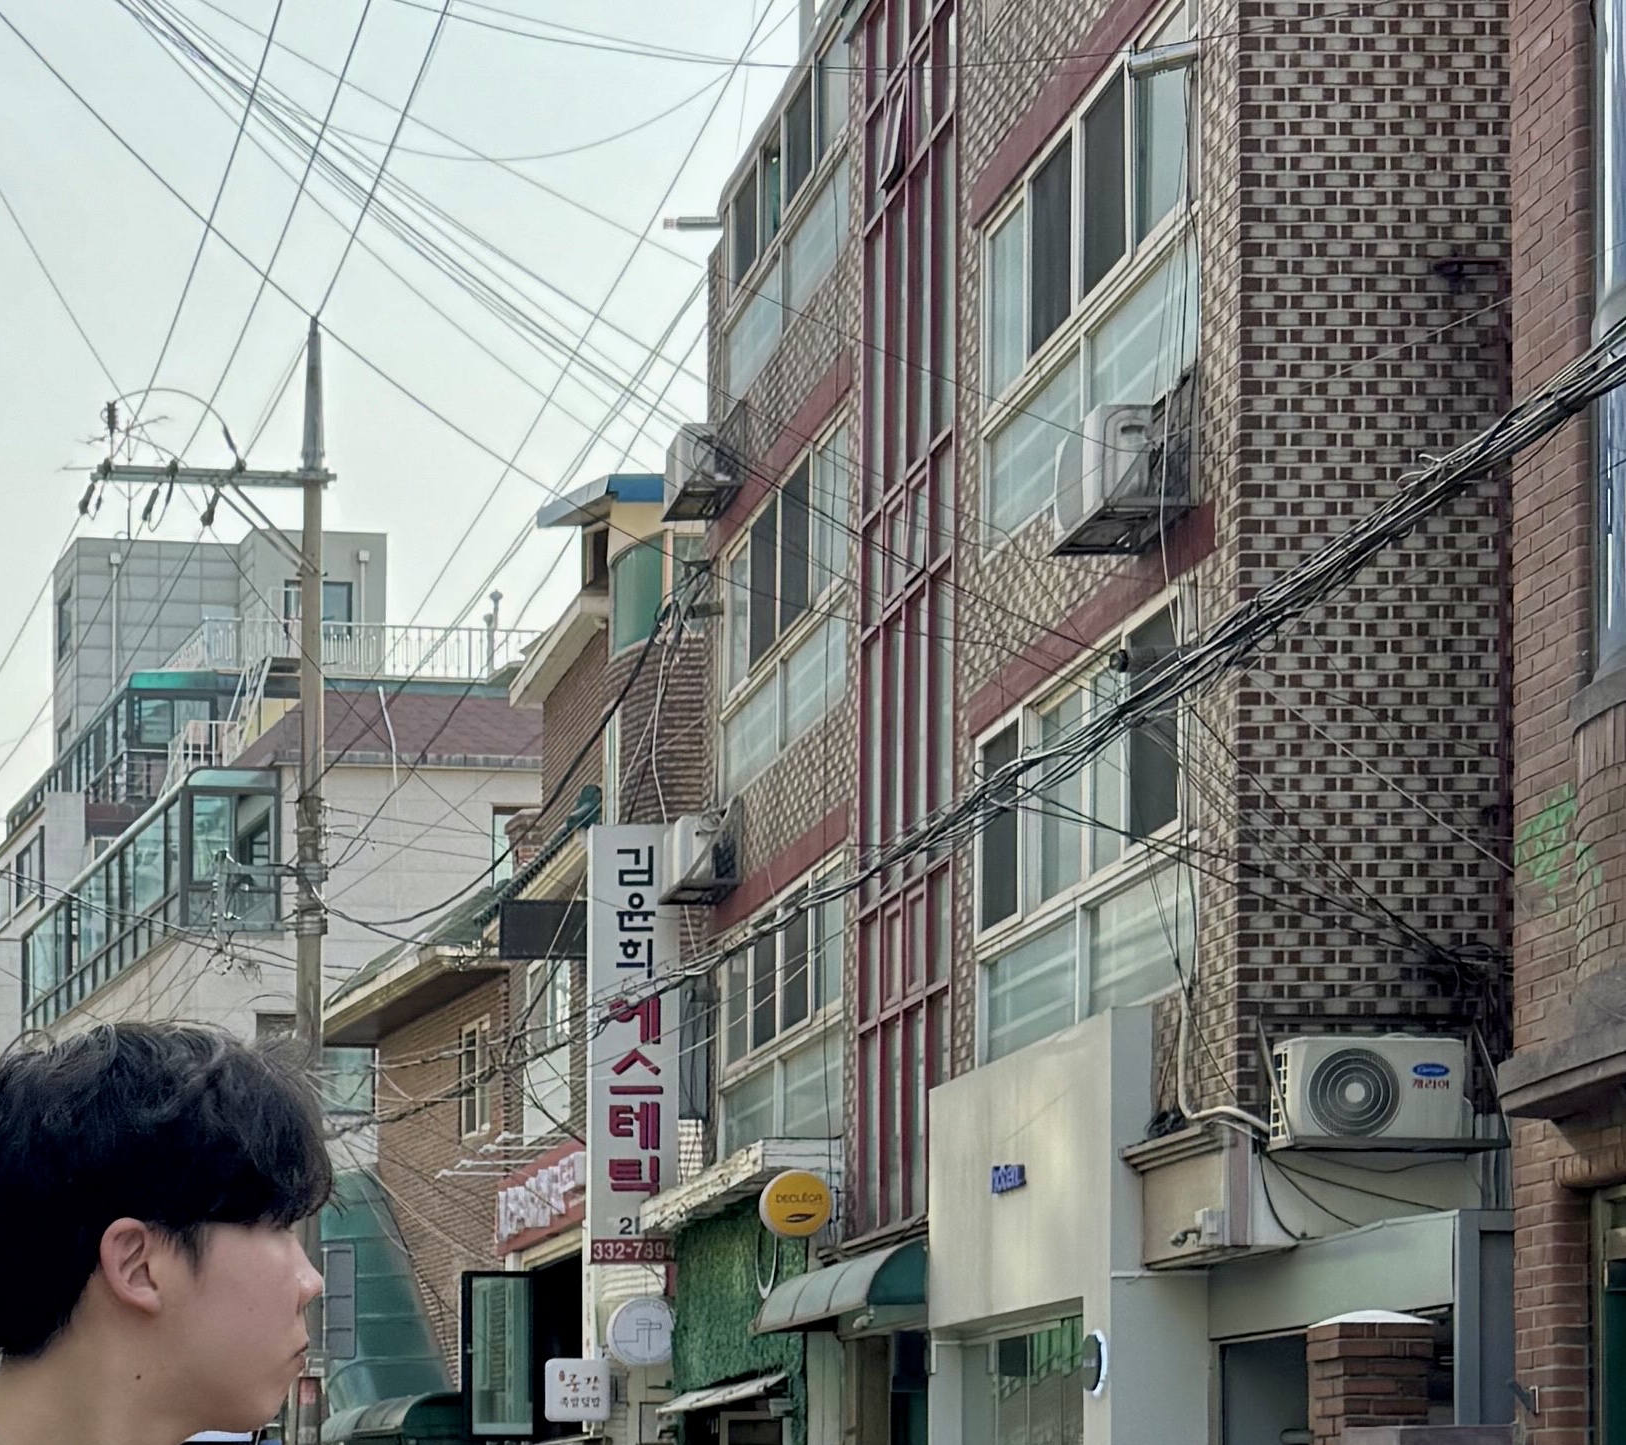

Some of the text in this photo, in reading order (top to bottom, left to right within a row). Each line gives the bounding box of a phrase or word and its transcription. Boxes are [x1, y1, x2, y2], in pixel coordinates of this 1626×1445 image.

[608, 845, 664, 1197] 김윤희 에스테틱
[1412, 1079, 1450, 1089] 캐리어
[593, 1242, 674, 1260] 332-7894
